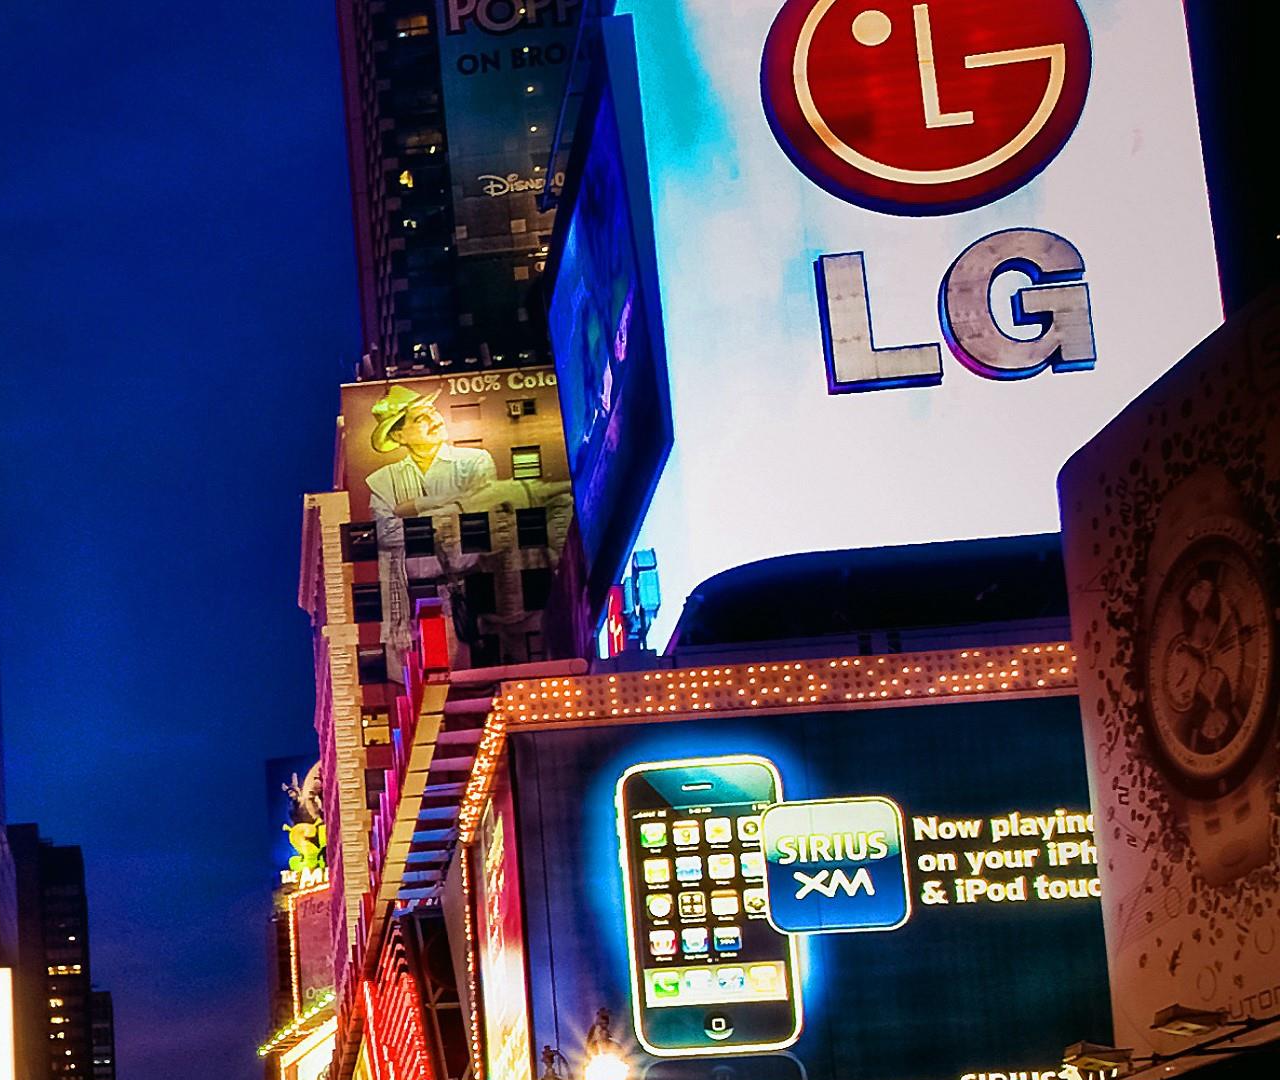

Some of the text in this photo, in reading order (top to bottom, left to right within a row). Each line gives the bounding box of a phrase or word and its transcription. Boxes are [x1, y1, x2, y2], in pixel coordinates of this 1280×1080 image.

[457, 52, 503, 76] ON
[814, 227, 1097, 395] LG
[448, 375, 501, 398] 100%
[913, 815, 982, 843] Now
[776, 830, 889, 867] SIRIUS
[917, 837, 1099, 881] on your iPh
[792, 868, 877, 901] XM
[920, 880, 949, 907] &
[955, 878, 1027, 904] iPod
